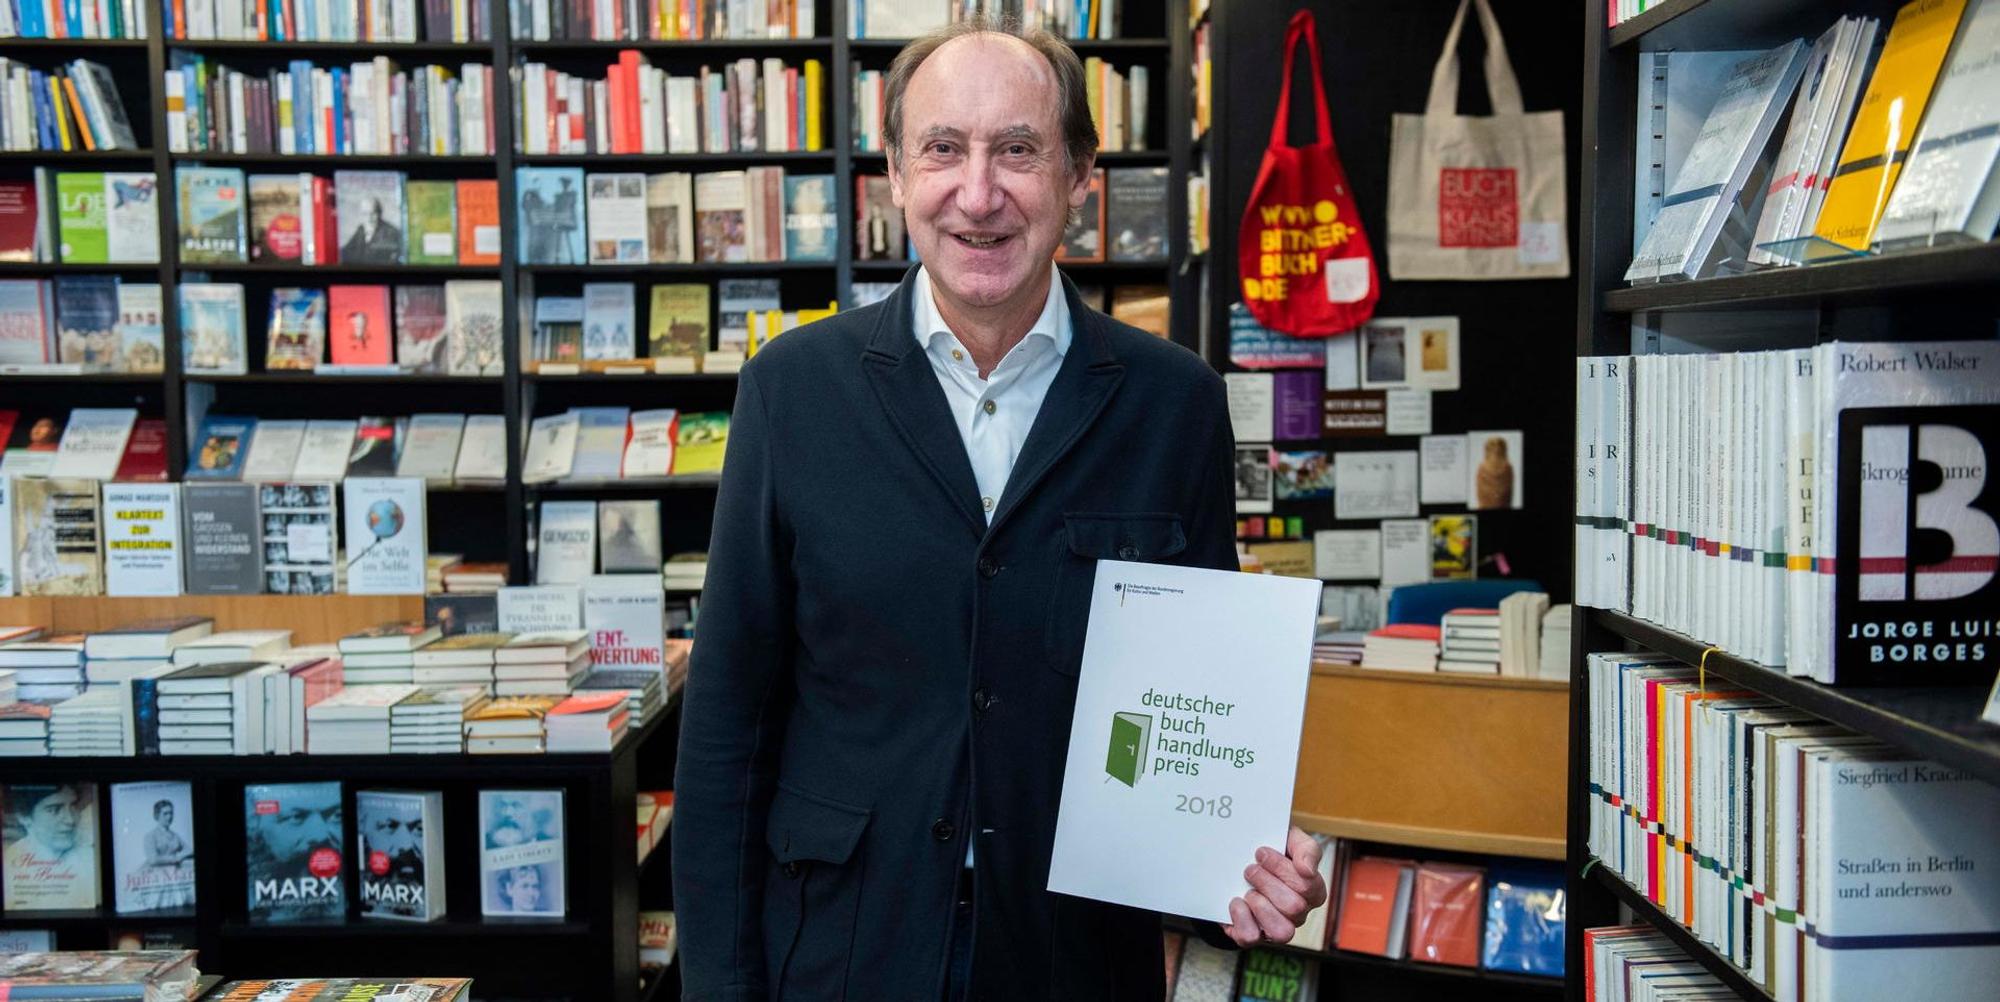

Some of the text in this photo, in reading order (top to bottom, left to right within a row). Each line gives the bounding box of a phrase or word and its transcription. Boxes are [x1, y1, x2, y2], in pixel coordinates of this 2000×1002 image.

[1443, 171, 1515, 198] BUCH
[1260, 252, 1318, 277] BUCH
[1839, 350, 1981, 373] Robert Walser
[116, 510, 165, 520] KLARTEXT
[192, 511, 215, 522] VOM
[131, 525, 151, 535] ZUR
[109, 540, 173, 550] INTEGRATION
[194, 544, 252, 555] WIDERSTAND
[596, 630, 629, 646] ENT-
[1848, 620, 2000, 638] JORGE LUIS
[587, 647, 660, 665] WERTUNG
[1870, 643, 1986, 663] BORGES
[1141, 688, 1236, 717] deutscher
[1160, 712, 1206, 735] buch
[1157, 733, 1256, 769] handlungs
[1153, 756, 1200, 776] preis
[1838, 766, 1908, 788] Siegfried
[1175, 794, 1234, 819] 2018
[1838, 856, 1974, 876] Straßen in Berlin
[255, 876, 339, 900] MARX
[364, 881, 424, 904] MARX
[1838, 882, 1953, 899] und anderswo
[1244, 971, 1299, 1002] TUN?
